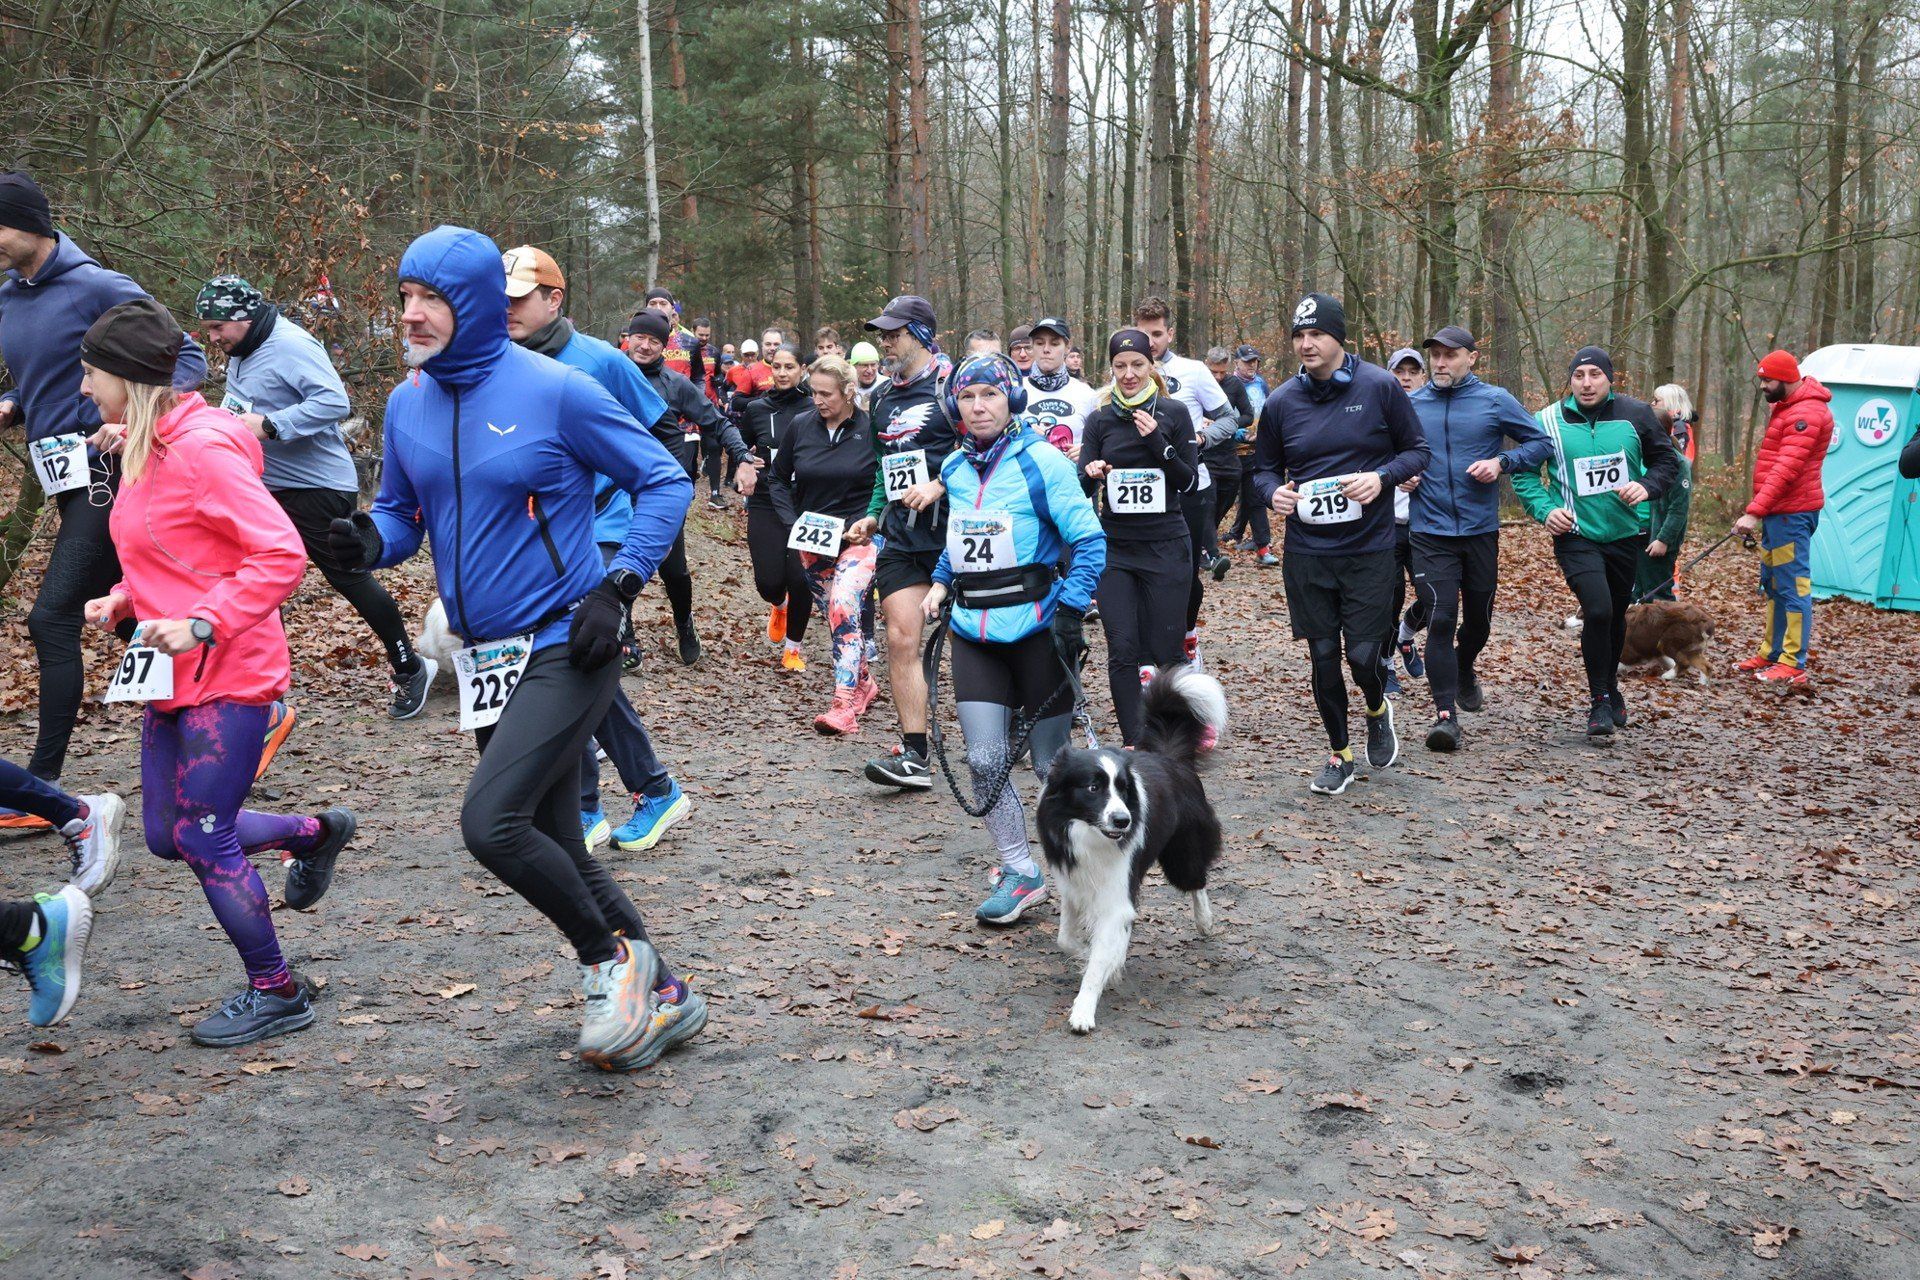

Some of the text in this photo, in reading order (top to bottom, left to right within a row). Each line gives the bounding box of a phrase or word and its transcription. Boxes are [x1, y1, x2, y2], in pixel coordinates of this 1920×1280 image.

[43, 456, 70, 482] 112
[889, 468, 917, 491] 221
[1585, 468, 1620, 488] 170
[1117, 485, 1153, 504] 218
[1310, 493, 1348, 517] 219
[796, 525, 833, 548] 242
[962, 538, 994, 564] 24
[470, 669, 520, 712] 228
